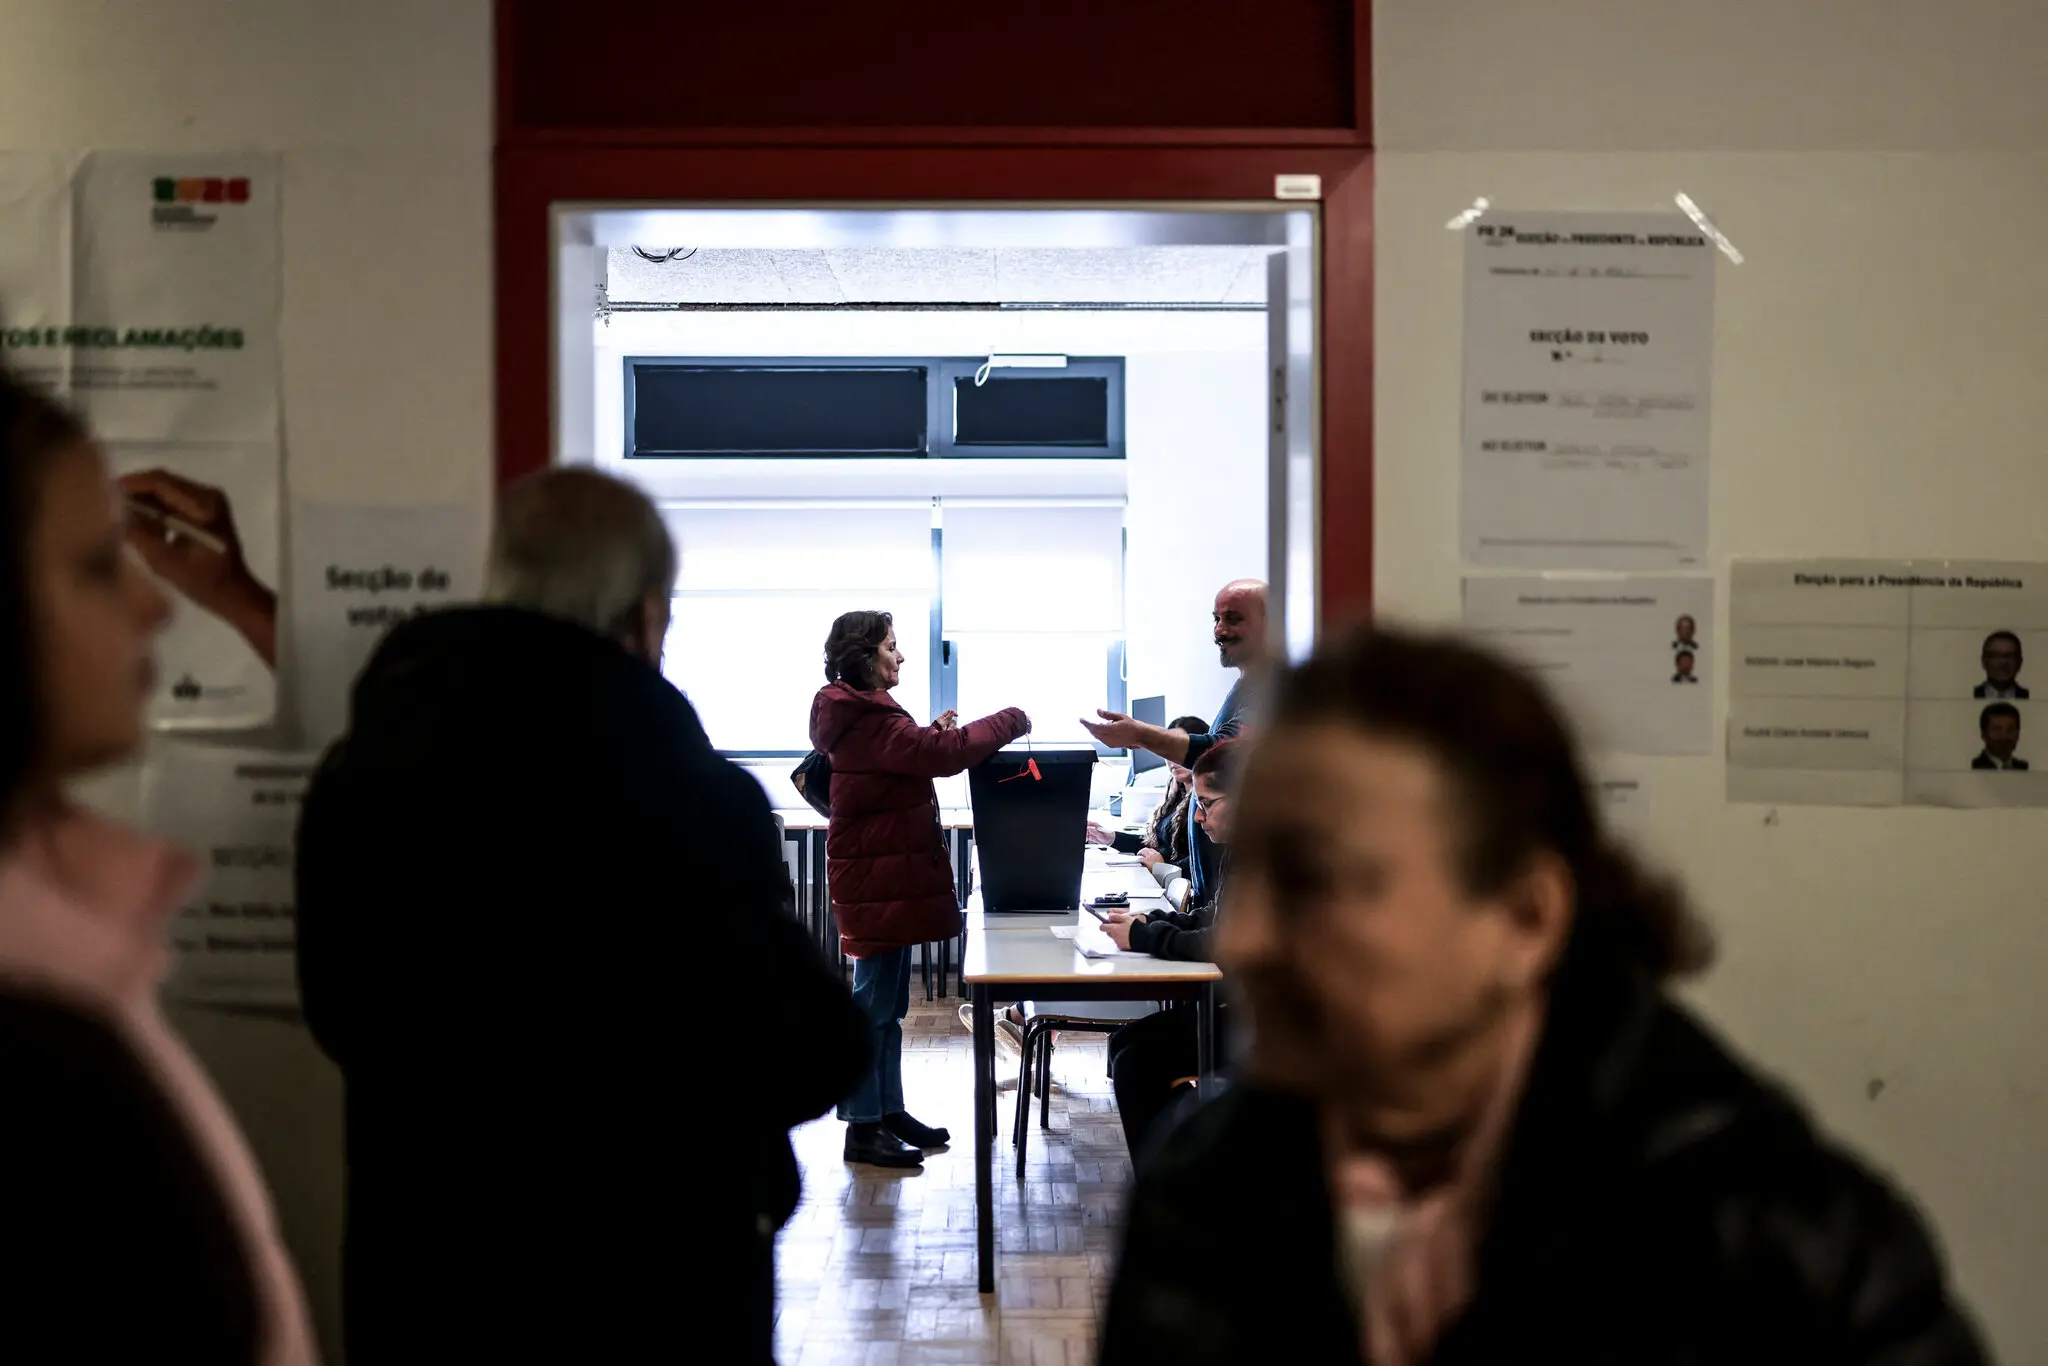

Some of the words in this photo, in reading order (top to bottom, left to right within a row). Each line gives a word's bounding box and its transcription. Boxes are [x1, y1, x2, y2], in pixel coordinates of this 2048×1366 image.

[63, 323, 245, 352] RECLAMAÇÕES
[1529, 327, 1584, 345] SECÇÃO
[1608, 331, 1650, 346] VOTO
[326, 563, 413, 594] Secção
[417, 565, 450, 592] de
[1794, 572, 1836, 588] Eleição
[1838, 575, 1865, 588] para
[1878, 574, 1946, 588] Presidência
[1948, 576, 1963, 588] da
[1965, 576, 2024, 590] República
